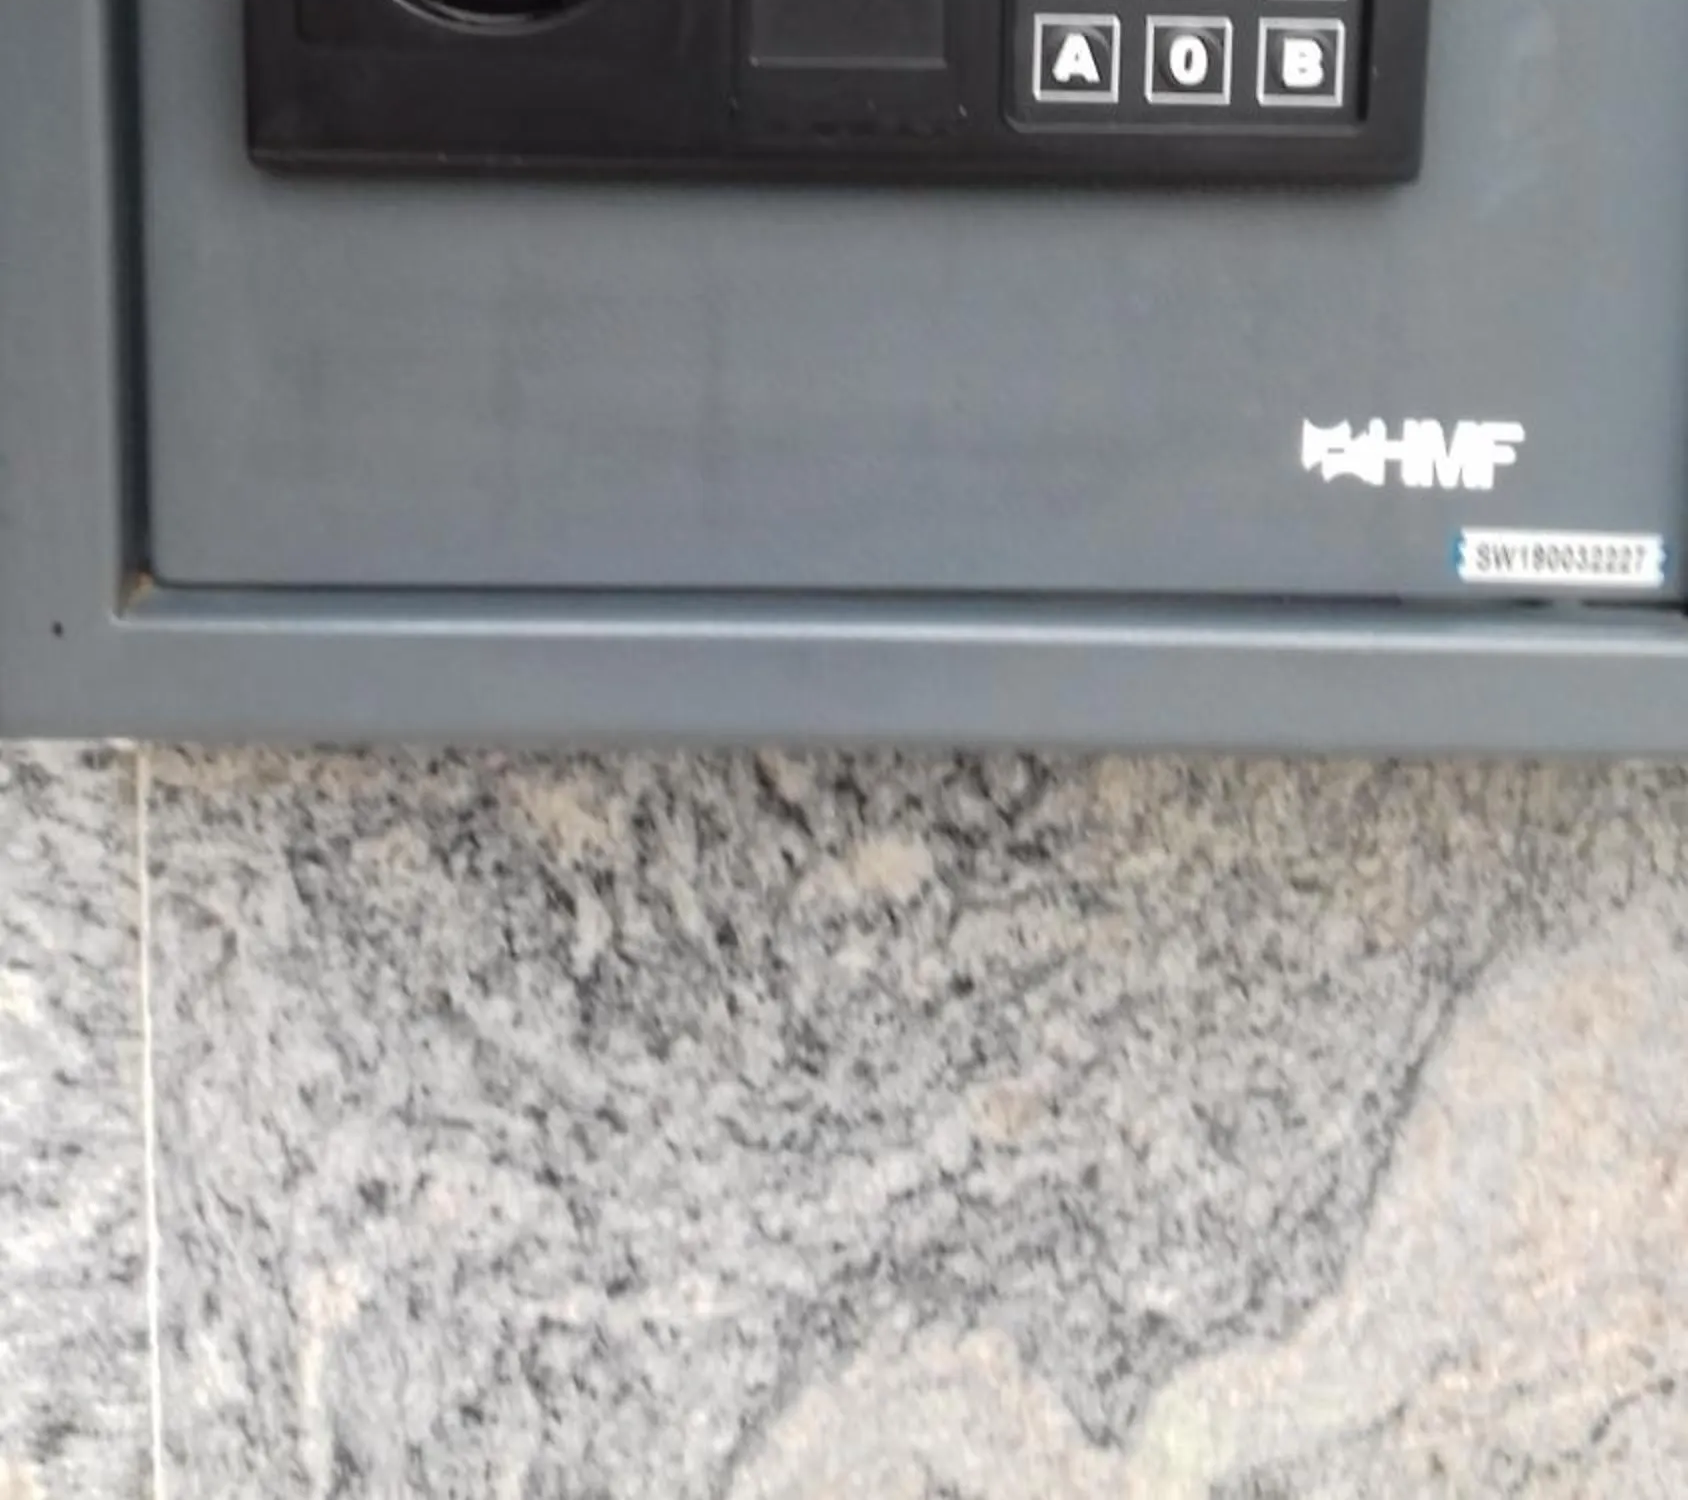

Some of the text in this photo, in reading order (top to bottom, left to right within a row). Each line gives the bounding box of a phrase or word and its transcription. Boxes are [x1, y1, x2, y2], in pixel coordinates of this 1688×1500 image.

[1052, 33, 1324, 88] A 0 B
[1369, 417, 1526, 491] HMF
